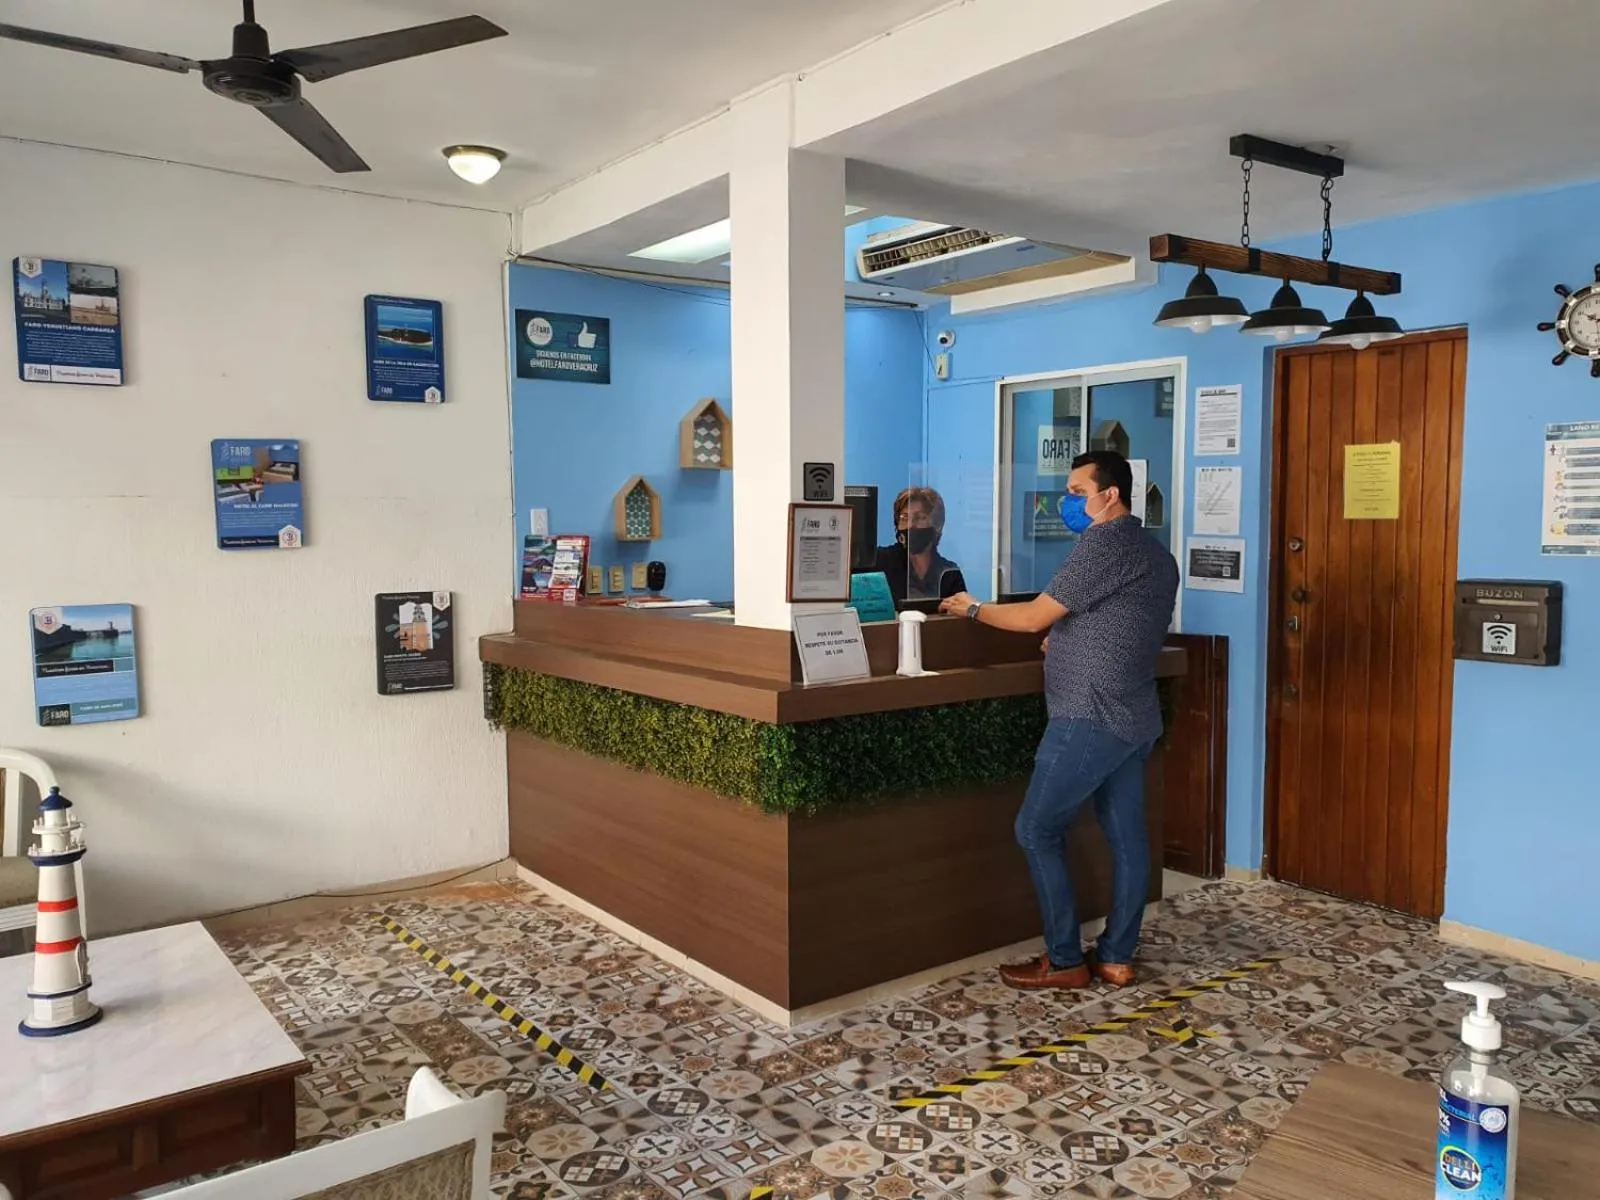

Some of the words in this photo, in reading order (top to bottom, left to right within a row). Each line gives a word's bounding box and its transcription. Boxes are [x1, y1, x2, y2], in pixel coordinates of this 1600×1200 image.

[230, 446, 251, 456] FARO
[1476, 589, 1523, 599] BUZON
[50, 710, 69, 719] FARO
[1443, 1153, 1476, 1171] DELLI
[1440, 1161, 1481, 1182] CLEAN
